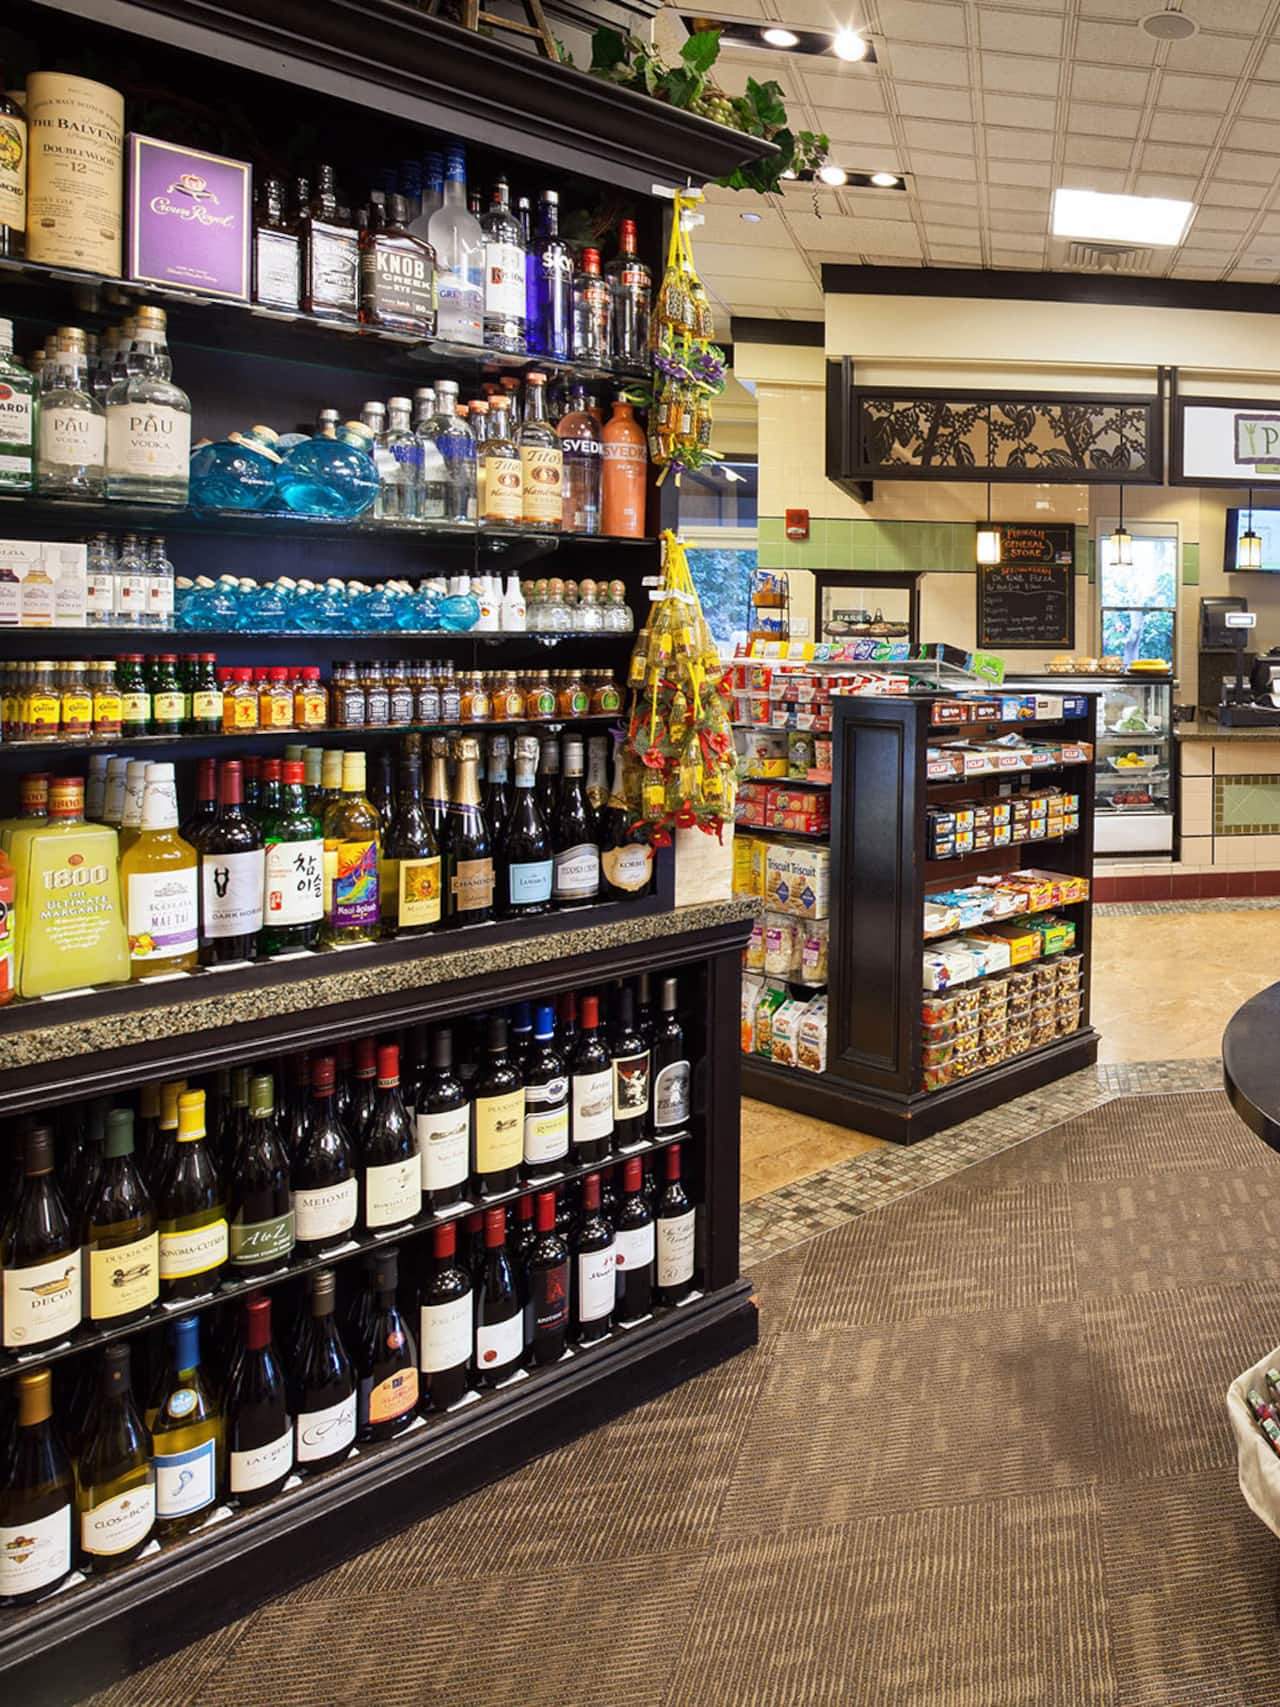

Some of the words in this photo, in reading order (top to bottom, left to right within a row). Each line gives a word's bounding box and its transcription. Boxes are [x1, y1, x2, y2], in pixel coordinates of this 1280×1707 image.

[33, 119, 55, 128] THE
[70, 161, 88, 175] 12
[150, 196, 191, 216] Crown
[181, 204, 236, 227] Royal
[376, 251, 425, 279] KNOB
[382, 273, 431, 291] CREEK
[131, 439, 171, 449] VODKA
[293, 852, 317, 876] 참
[767, 857, 791, 873] Triscuit
[791, 861, 817, 877] Triscuit
[42, 864, 110, 890] 1800
[297, 873, 323, 899] 이슬
[46, 895, 108, 911] ULTIMATE
[39, 904, 114, 921] MARGARITA
[212, 911, 239, 921] DARK
[31, 1288, 73, 1309] DECOY
[94, 1516, 122, 1530] CLOS
